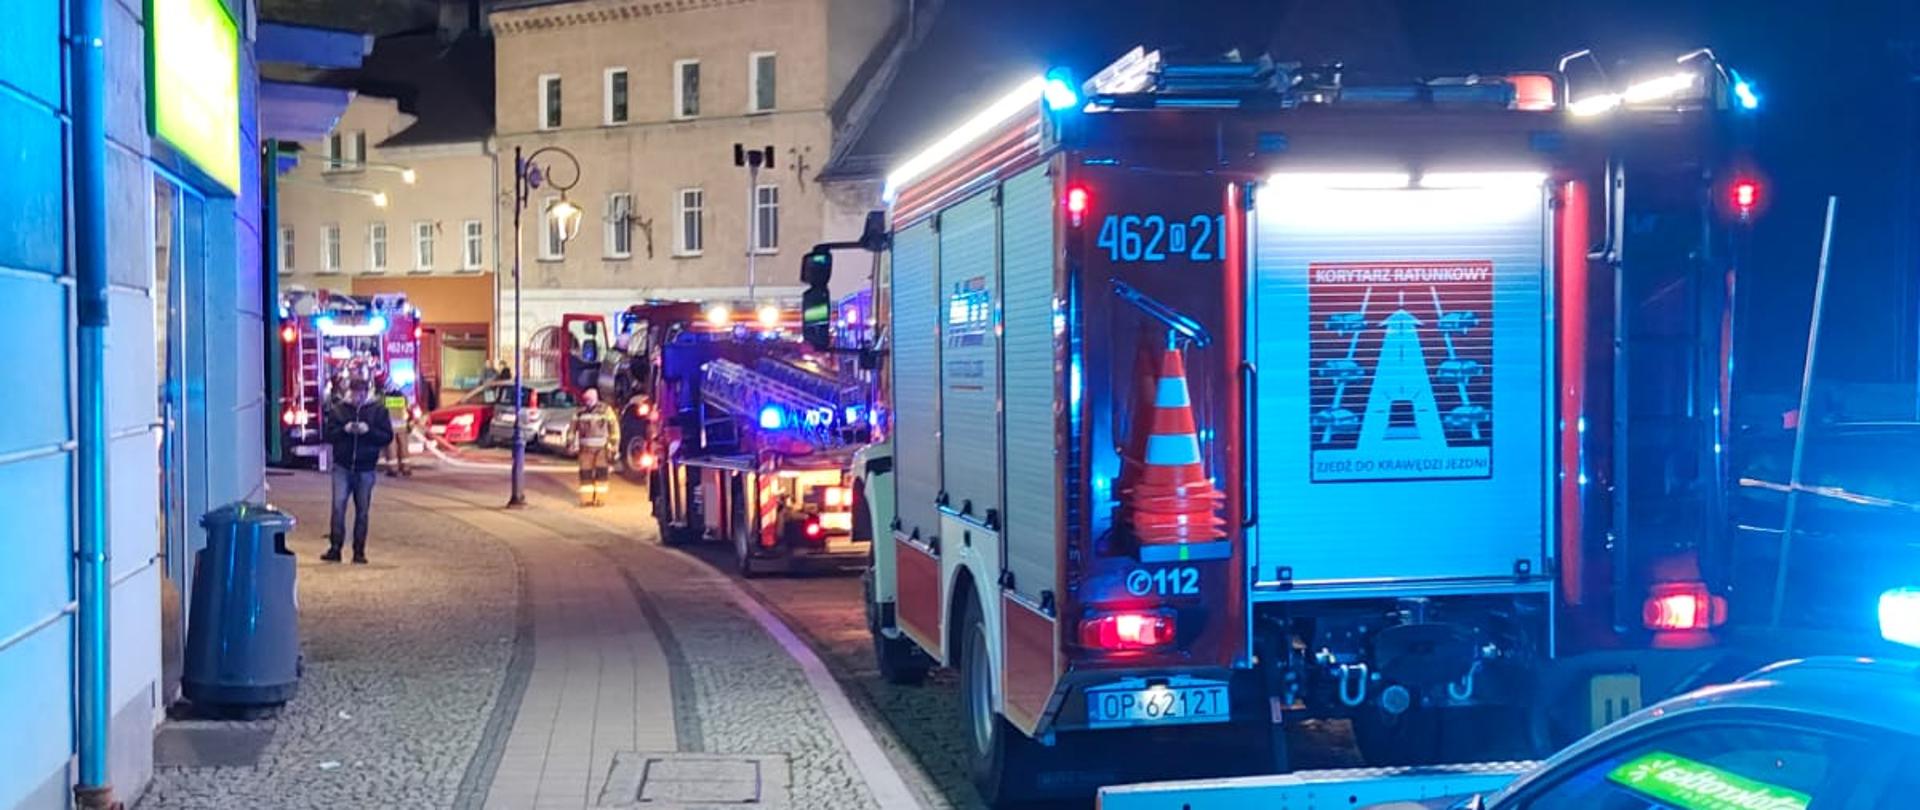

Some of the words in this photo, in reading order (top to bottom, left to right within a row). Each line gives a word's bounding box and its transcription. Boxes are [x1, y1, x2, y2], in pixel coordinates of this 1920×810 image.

[1316, 268, 1391, 283] KORYTARZ
[1394, 266, 1488, 282] RATUNKOWY
[1356, 460, 1374, 472] DO
[1379, 458, 1443, 473] KRAWĘDZI
[1445, 457, 1488, 471] JEZDNI
[1153, 566, 1200, 595] 112
[1104, 693, 1135, 719] OP
[1146, 689, 1222, 718] 6212T
